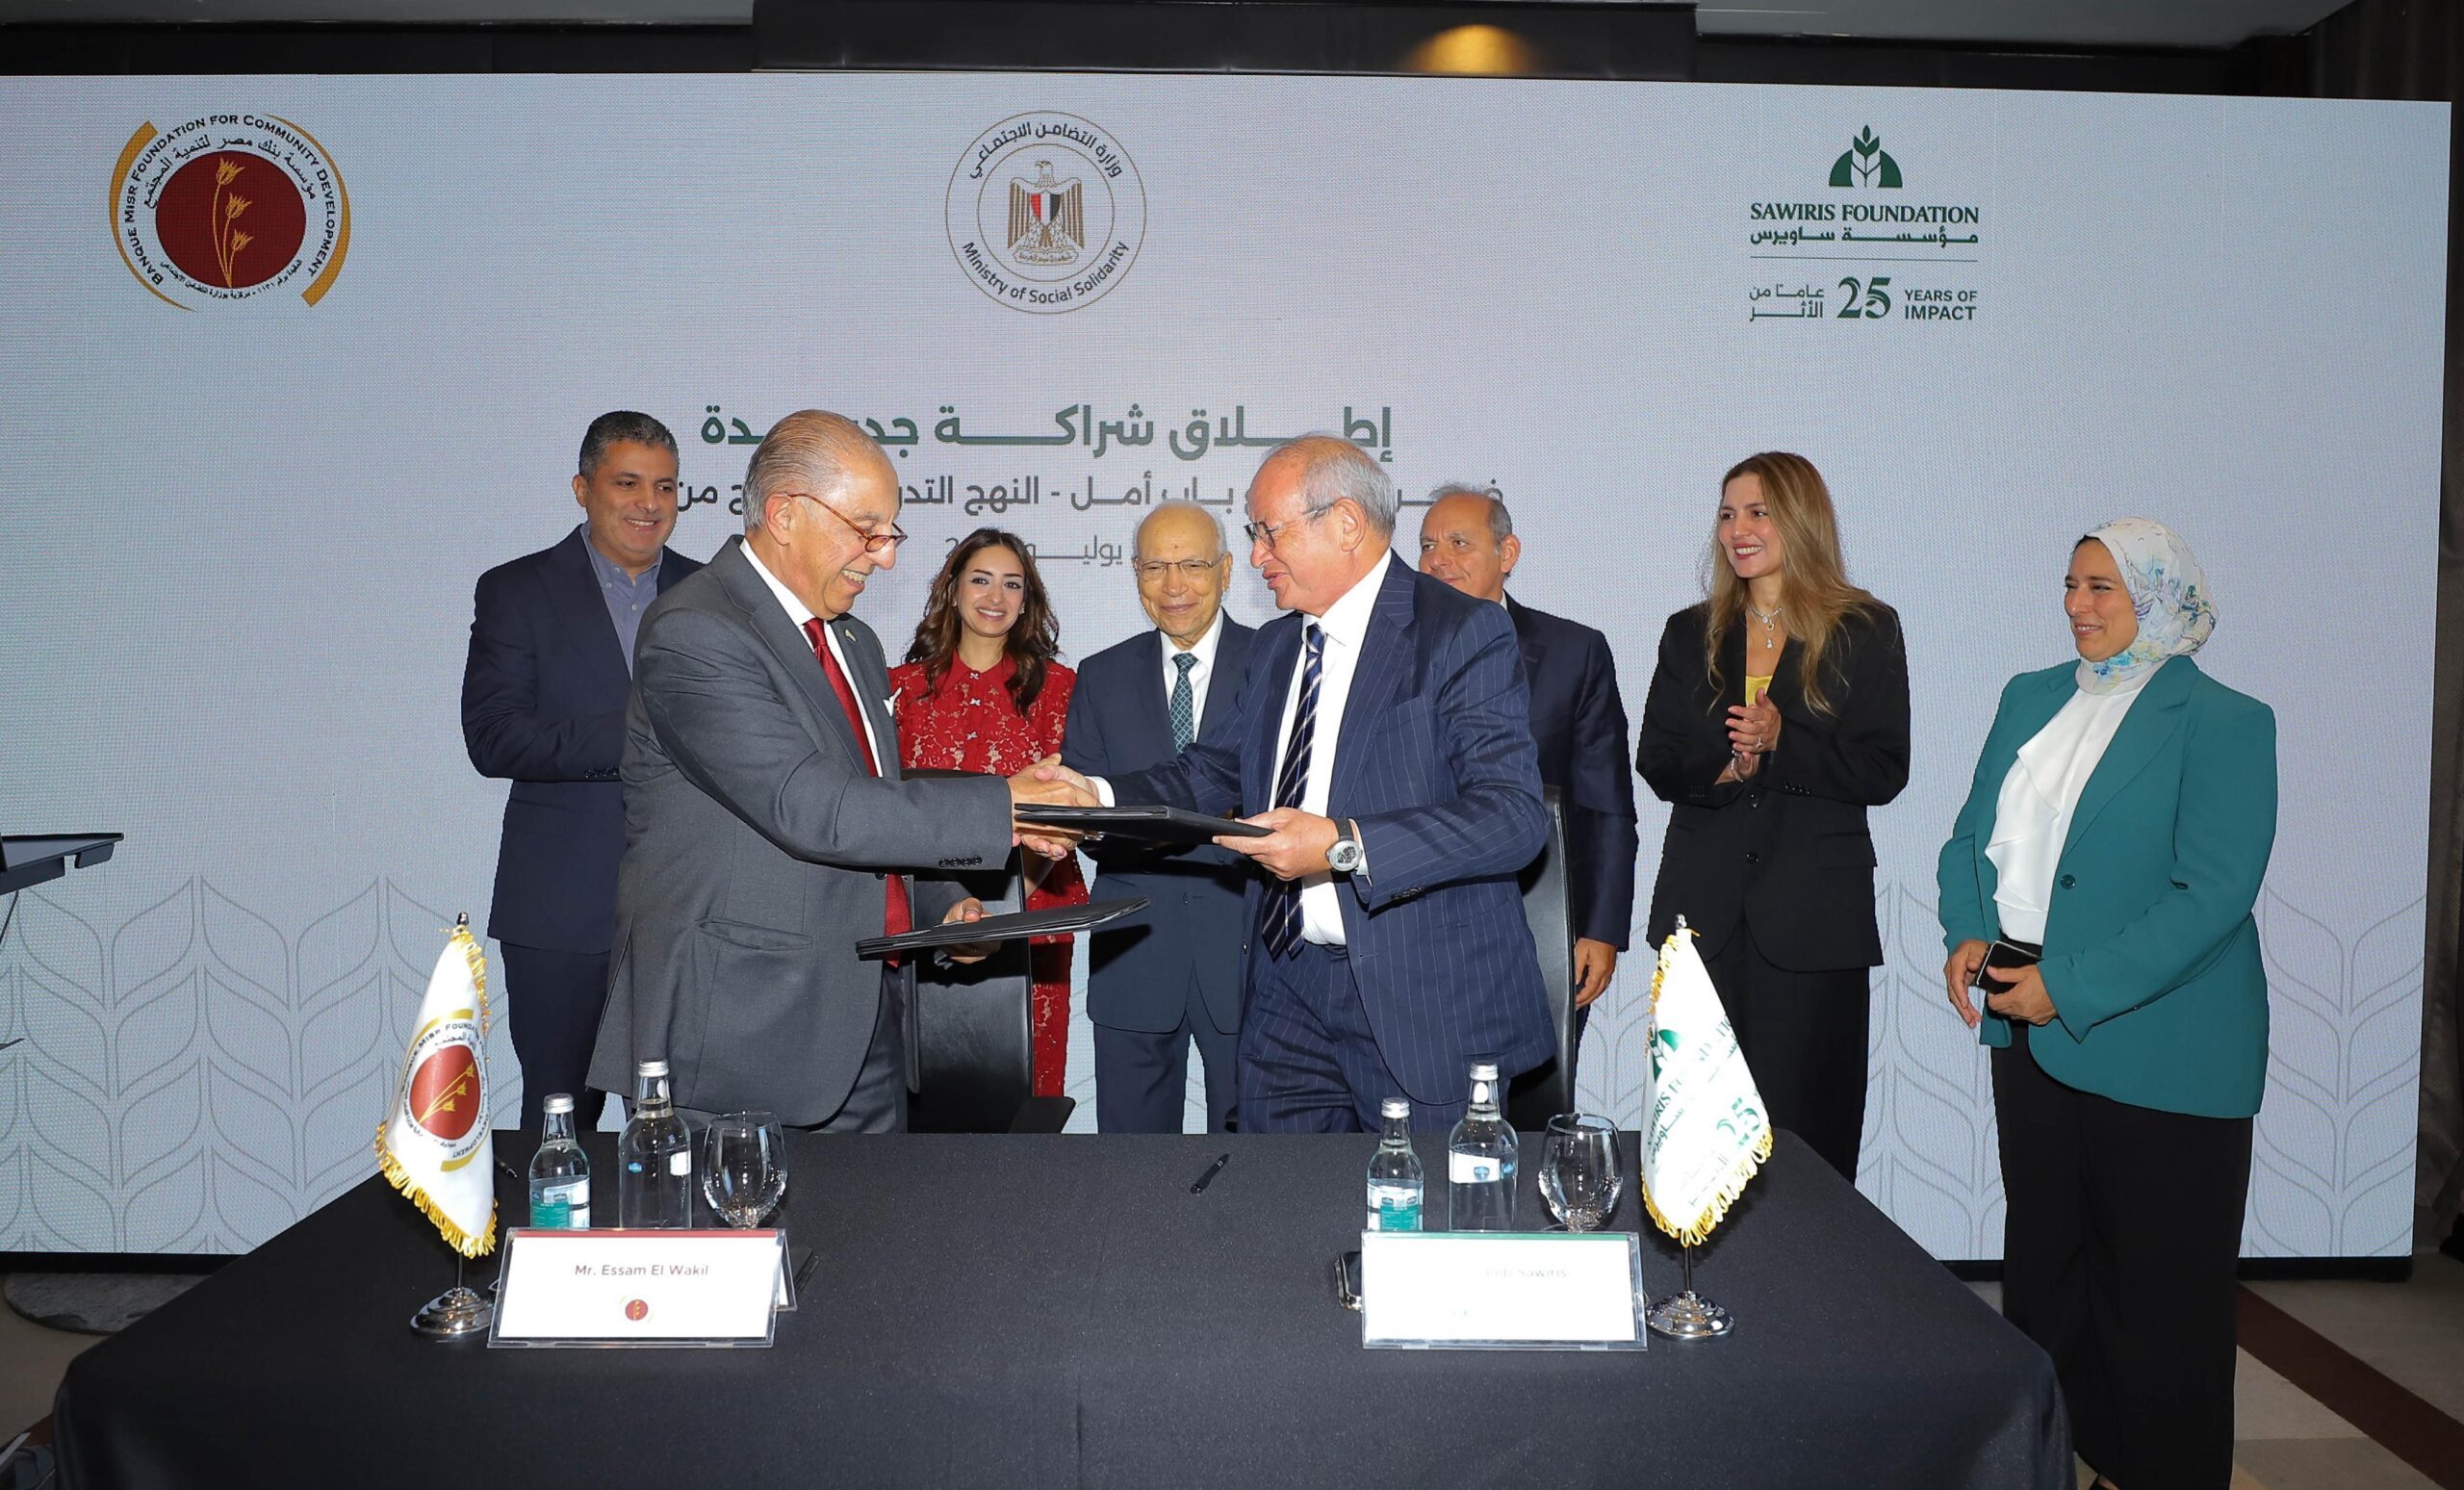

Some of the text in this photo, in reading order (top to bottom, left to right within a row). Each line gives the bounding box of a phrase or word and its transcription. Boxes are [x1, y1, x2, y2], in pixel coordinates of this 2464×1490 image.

[217, 138, 253, 149] مصر
[257, 140, 281, 160] بنك
[969, 122, 1122, 179] وزارة التضامن الاجتماعي
[143, 157, 172, 209] المجتمع
[284, 152, 316, 199] مؤسسة
[124, 115, 336, 286] BANQUE MISR FOUNDATION FOR COMMUNITY DEVELOPMENT
[1750, 202, 1979, 223] SAWIRIS FOUNDATION
[1750, 225, 1979, 248] مؤسسة ساويرس
[962, 241, 1129, 304] Ministry of Social Solidarity
[1749, 287, 1771, 301] من
[1836, 276, 1892, 320] 25
[1905, 290, 1978, 302] YEARS OF
[1749, 300, 1824, 321] الأثر
[1905, 305, 1977, 321] IMPACT
[701, 403, 1394, 463] إطلاق شراكة جددة
[963, 475, 1040, 516] النهج
[1070, 470, 1152, 511] أمل
[575, 1264, 708, 1276] Mr. Essam El Wakil
